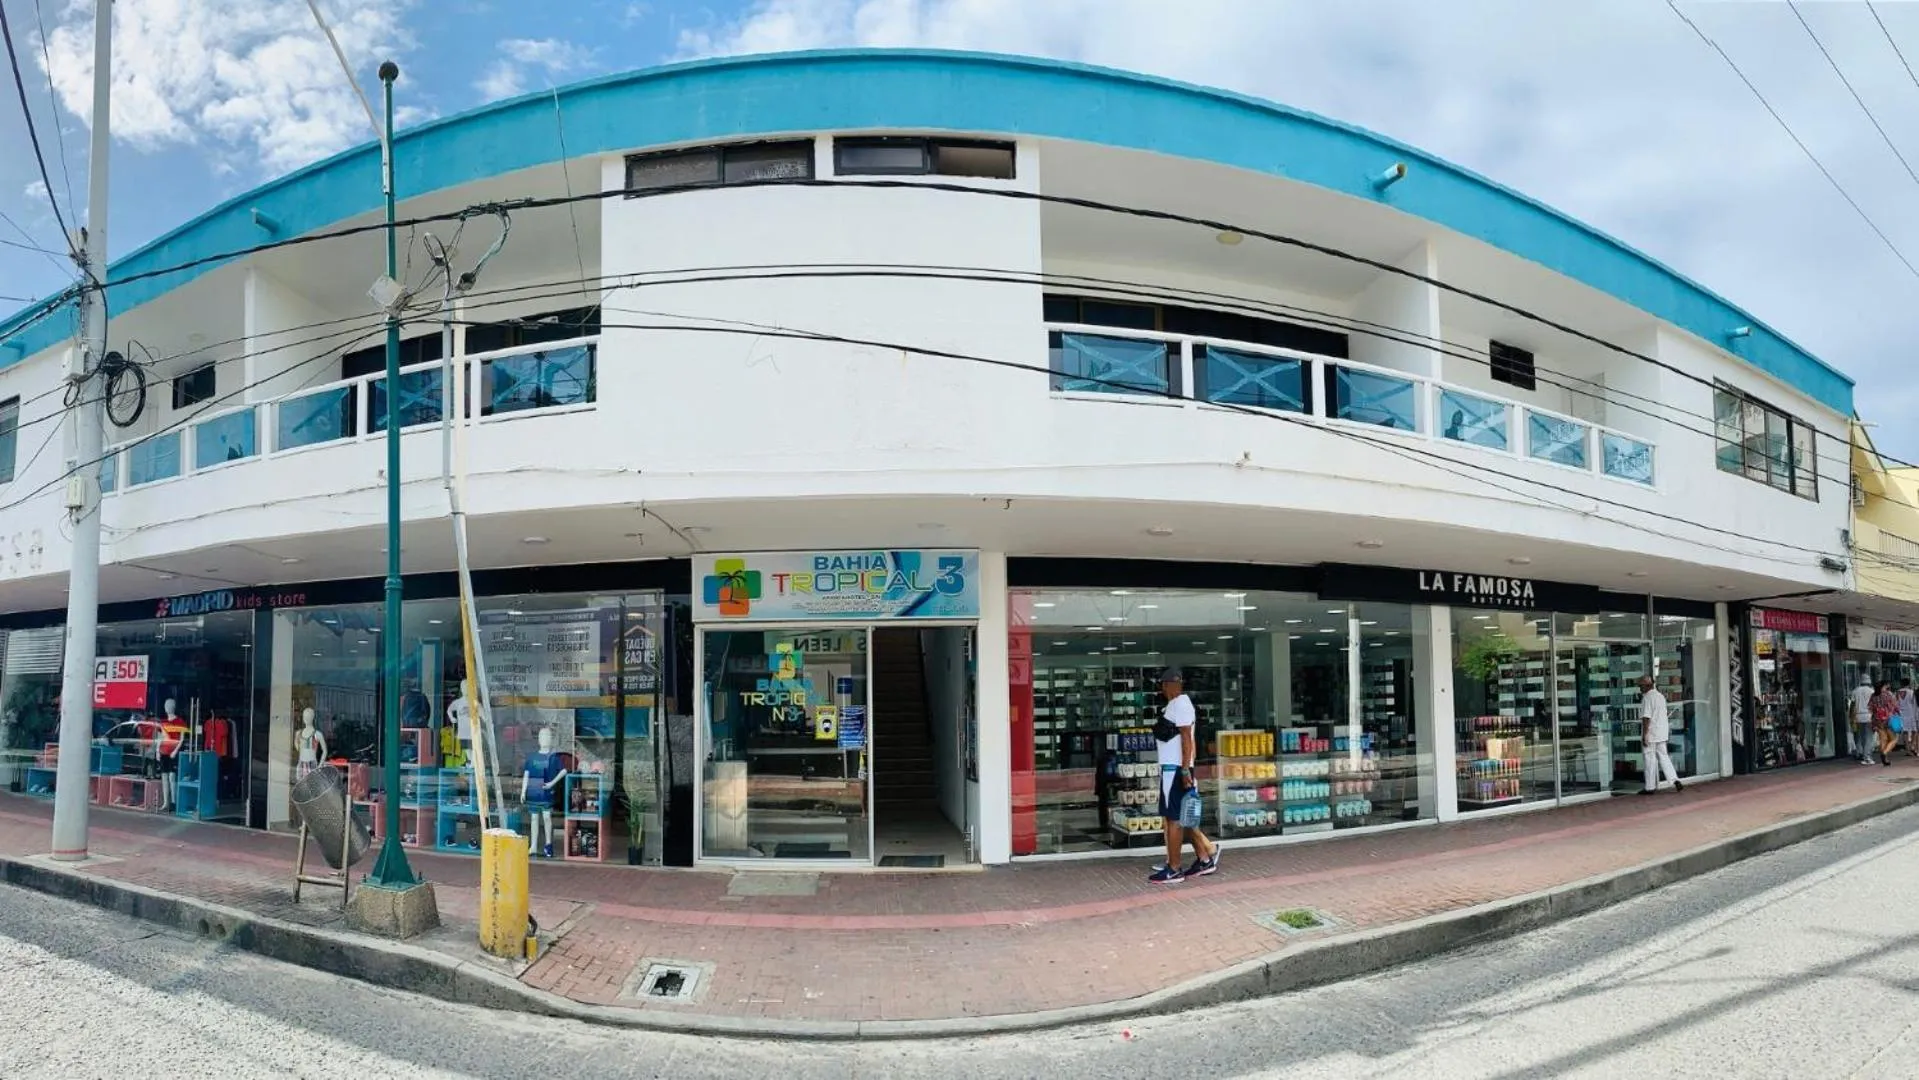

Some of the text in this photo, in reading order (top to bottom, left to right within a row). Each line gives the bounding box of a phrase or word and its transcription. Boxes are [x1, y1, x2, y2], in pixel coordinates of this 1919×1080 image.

[814, 555, 887, 571] BAHIA
[772, 571, 934, 594] TROPICAL
[935, 555, 965, 597] 3
[1419, 571, 1534, 598] LA FAMOSA
[171, 591, 306, 616] MADRID kids store
